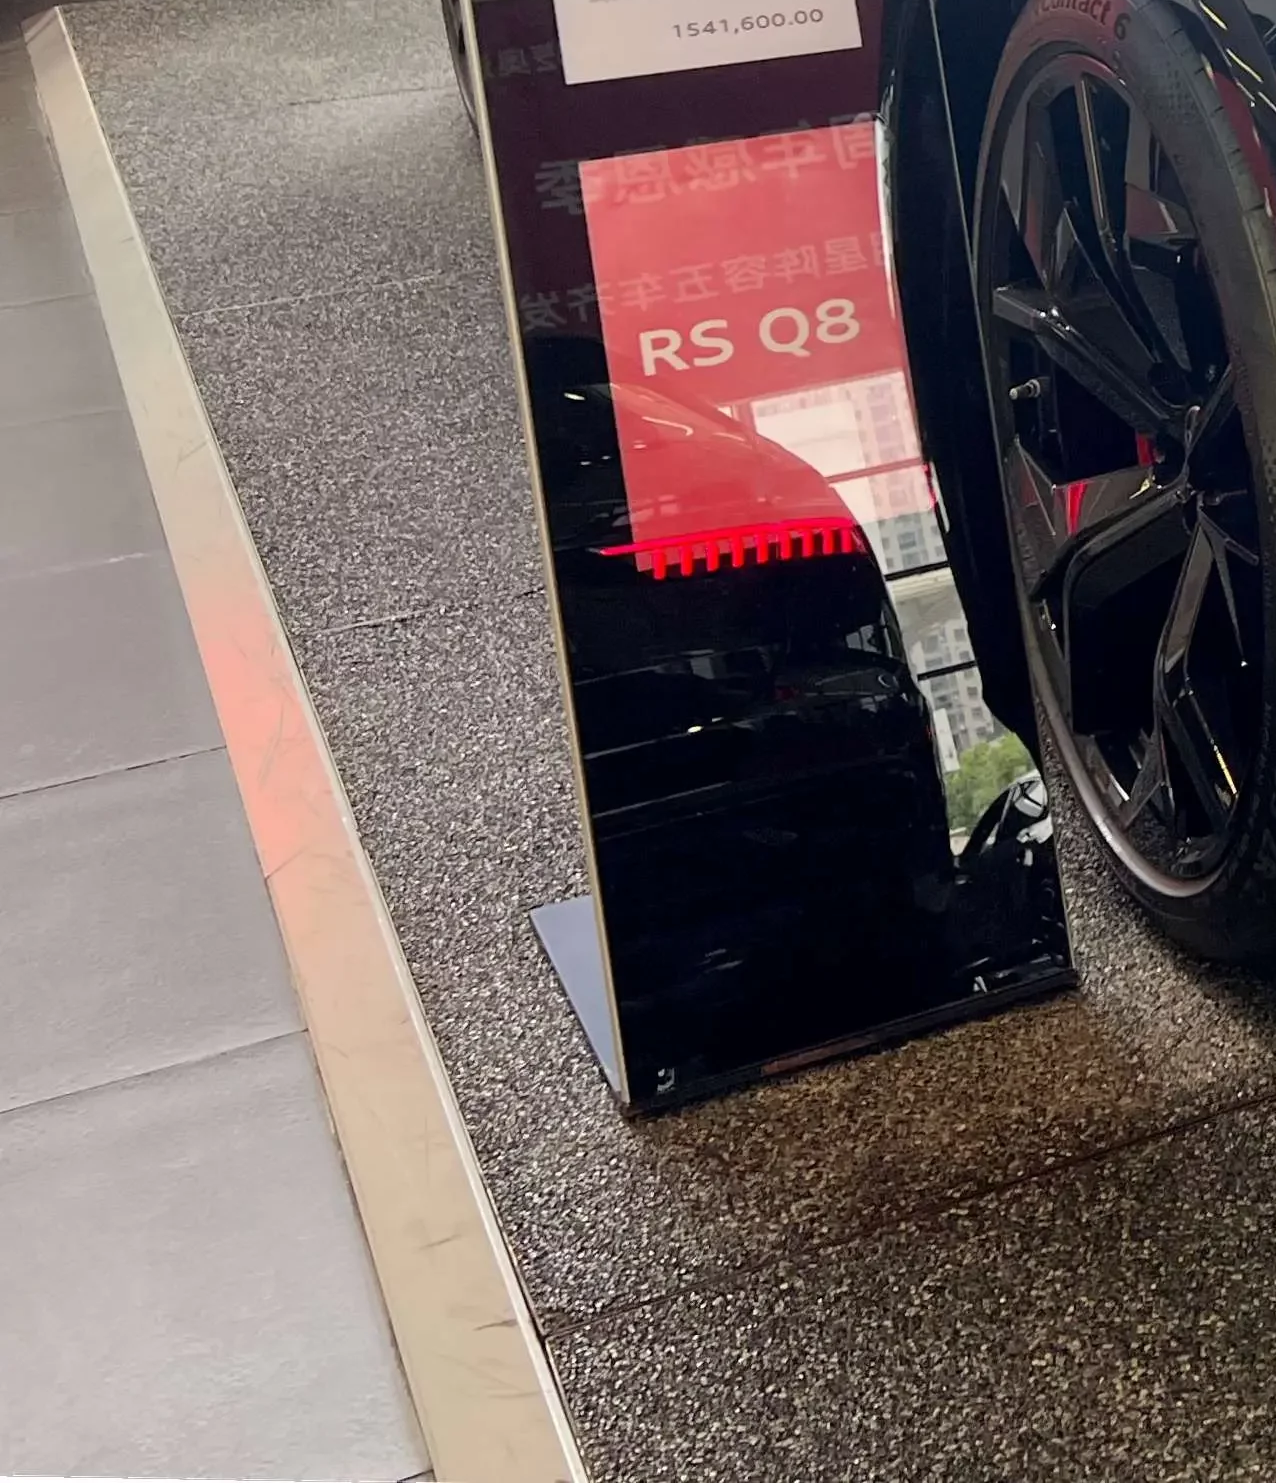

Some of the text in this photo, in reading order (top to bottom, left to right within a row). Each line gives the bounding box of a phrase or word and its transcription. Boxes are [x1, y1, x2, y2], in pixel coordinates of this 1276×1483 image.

[671, 7, 825, 40] 1541,600.00
[1114, 12, 1132, 41] 6
[638, 298, 861, 377] RS Q8
